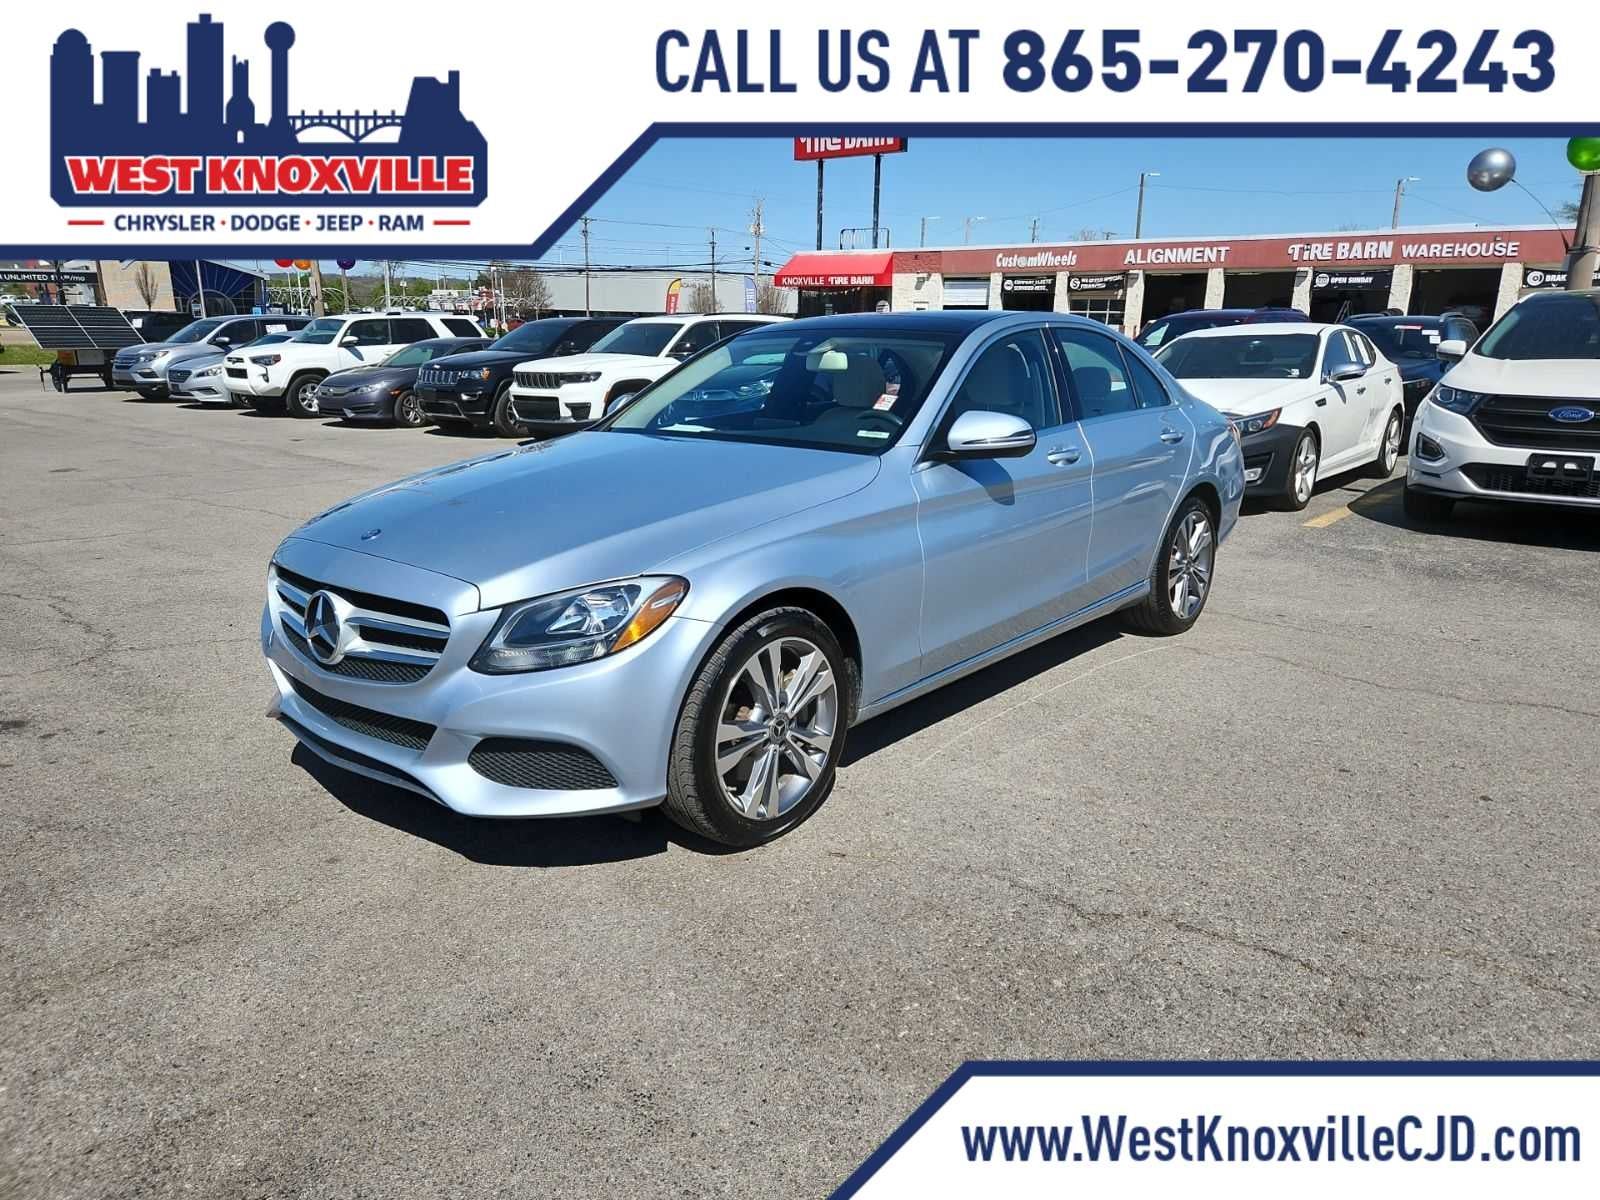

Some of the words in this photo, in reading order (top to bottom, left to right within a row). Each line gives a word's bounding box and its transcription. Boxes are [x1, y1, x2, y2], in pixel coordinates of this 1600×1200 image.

[1124, 246, 1231, 264] ALIGNMENT
[1337, 241, 1394, 259] BARN
[1401, 241, 1520, 258] WAREHOUSE
[782, 276, 824, 285] KNOXVILLE
[851, 276, 874, 285] BARN
[1330, 276, 1347, 284] OPEN
[1348, 276, 1373, 284] SUNDAY
